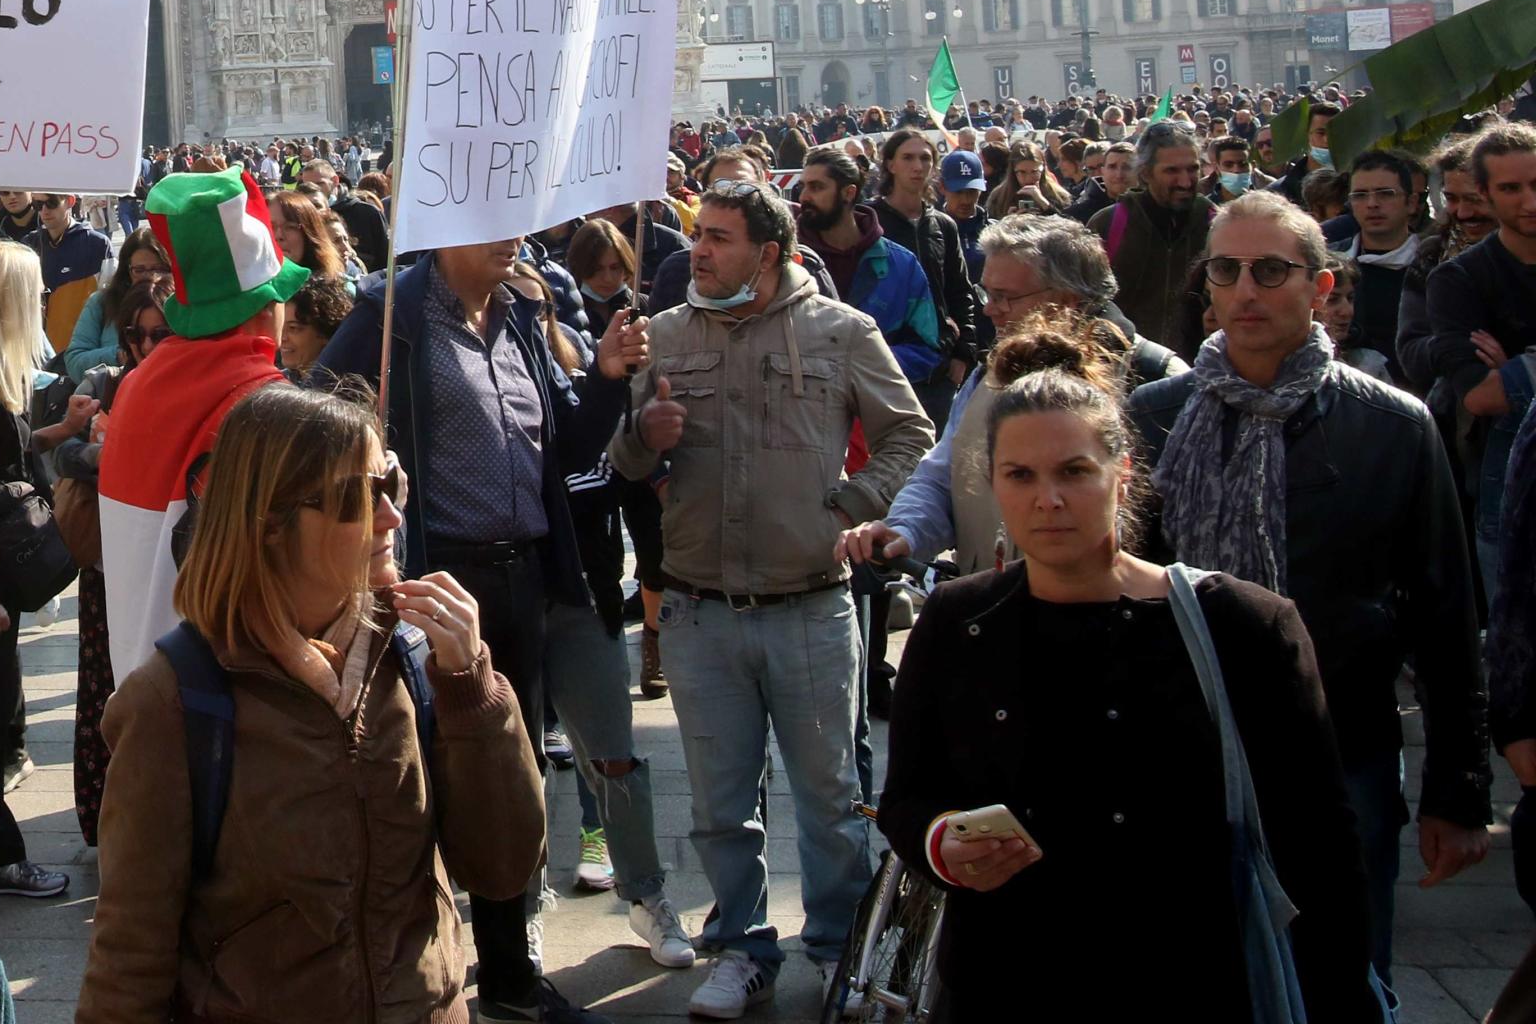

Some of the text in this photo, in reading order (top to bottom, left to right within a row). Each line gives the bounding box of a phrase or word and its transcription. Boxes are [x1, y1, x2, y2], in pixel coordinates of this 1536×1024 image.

[425, 50, 535, 128] PENSA
[41, 122, 119, 158] PASS
[417, 141, 472, 207] SU
[486, 140, 538, 202] PER
